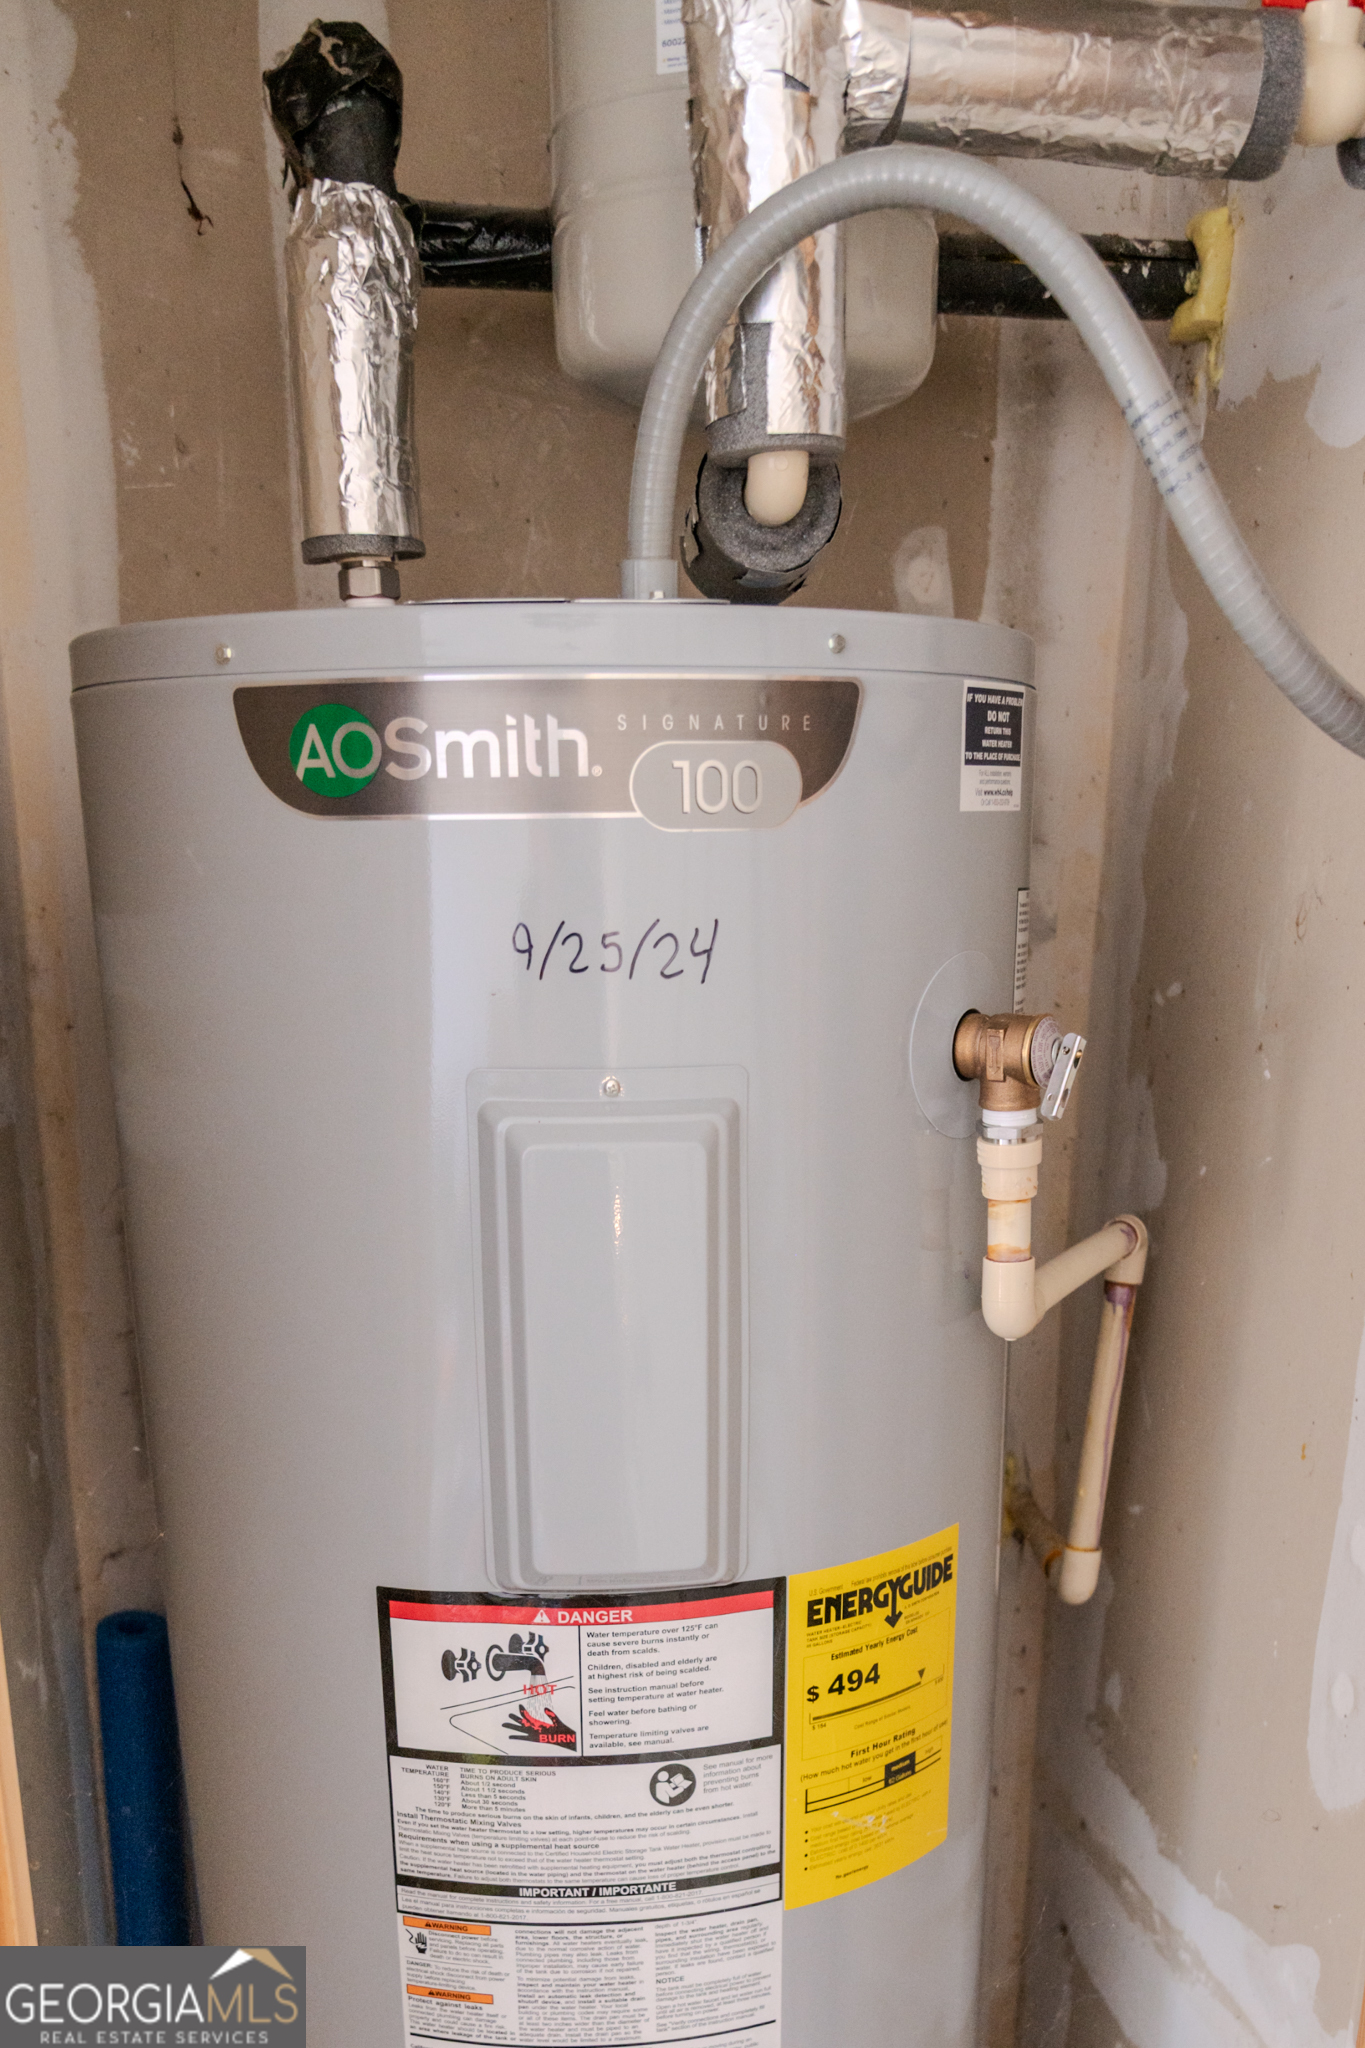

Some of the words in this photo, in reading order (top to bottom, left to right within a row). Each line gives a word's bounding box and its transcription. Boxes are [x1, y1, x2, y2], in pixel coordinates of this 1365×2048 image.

[967, 693, 973, 702] IF
[974, 694, 986, 703] YOU
[988, 695, 1001, 705] HAVE
[1001, 697, 1006, 705] A
[616, 714, 812, 732] SIGNATURE
[987, 710, 997, 721] DO
[998, 711, 1010, 723] NOT
[671, 759, 763, 815] 100
[512, 918, 719, 984] 9/25/24
[807, 1553, 953, 1628] ENERGYGUIDE
[557, 1609, 633, 1625] DANGER
[612, 1629, 659, 1638] temperature
[666, 1634, 699, 1643] instantly
[831, 1646, 863, 1660] Estimated
[865, 1639, 884, 1651] Yearly
[886, 1633, 905, 1644] Energy
[907, 1626, 918, 1636] Cost
[626, 1661, 659, 1670] disabled
[678, 1657, 703, 1666] elderly
[598, 1672, 627, 1681] highest
[656, 1668, 677, 1676] being
[605, 1685, 647, 1693] instruction
[650, 1683, 678, 1691] manual
[680, 1680, 704, 1688] before
[806, 1685, 819, 1703] $
[828, 1662, 880, 1695] 494
[523, 1684, 557, 1695] HOT
[617, 1694, 664, 1702] temperature
[658, 1705, 687, 1713] bathing
[539, 1733, 576, 1743] BURN
[589, 1732, 638, 1740] Temperature
[851, 1746, 869, 1758] First
[872, 1738, 891, 1750] Hour
[893, 1728, 916, 1742] Rating
[719, 1759, 744, 1768] manual
[820, 1767, 839, 1776] much
[841, 1763, 852, 1771] hot
[854, 1757, 871, 1768] water
[872, 1753, 884, 1762] you
[901, 1740, 910, 1748] the
[401, 1767, 449, 1777] TEMPERATURE
[703, 1768, 741, 1778] information
[743, 1764, 761, 1772] about
[703, 1776, 739, 1787] preventing
[741, 1772, 759, 1780] burns
[397, 1811, 418, 1820] Install
[420, 1813, 468, 1825] Thermostatic
[470, 1819, 495, 1827] Mixing
[398, 1832, 447, 1844] Requirements
[501, 1842, 552, 1850] supplemental
[519, 1888, 590, 1897] IMPORTANT
[592, 1888, 596, 1897] /
[599, 1882, 677, 1896] IMPORTANTE
[432, 1922, 468, 1931] WARNING
[656, 1976, 684, 1984] NOTICE
[435, 1991, 471, 2000] WARNING
